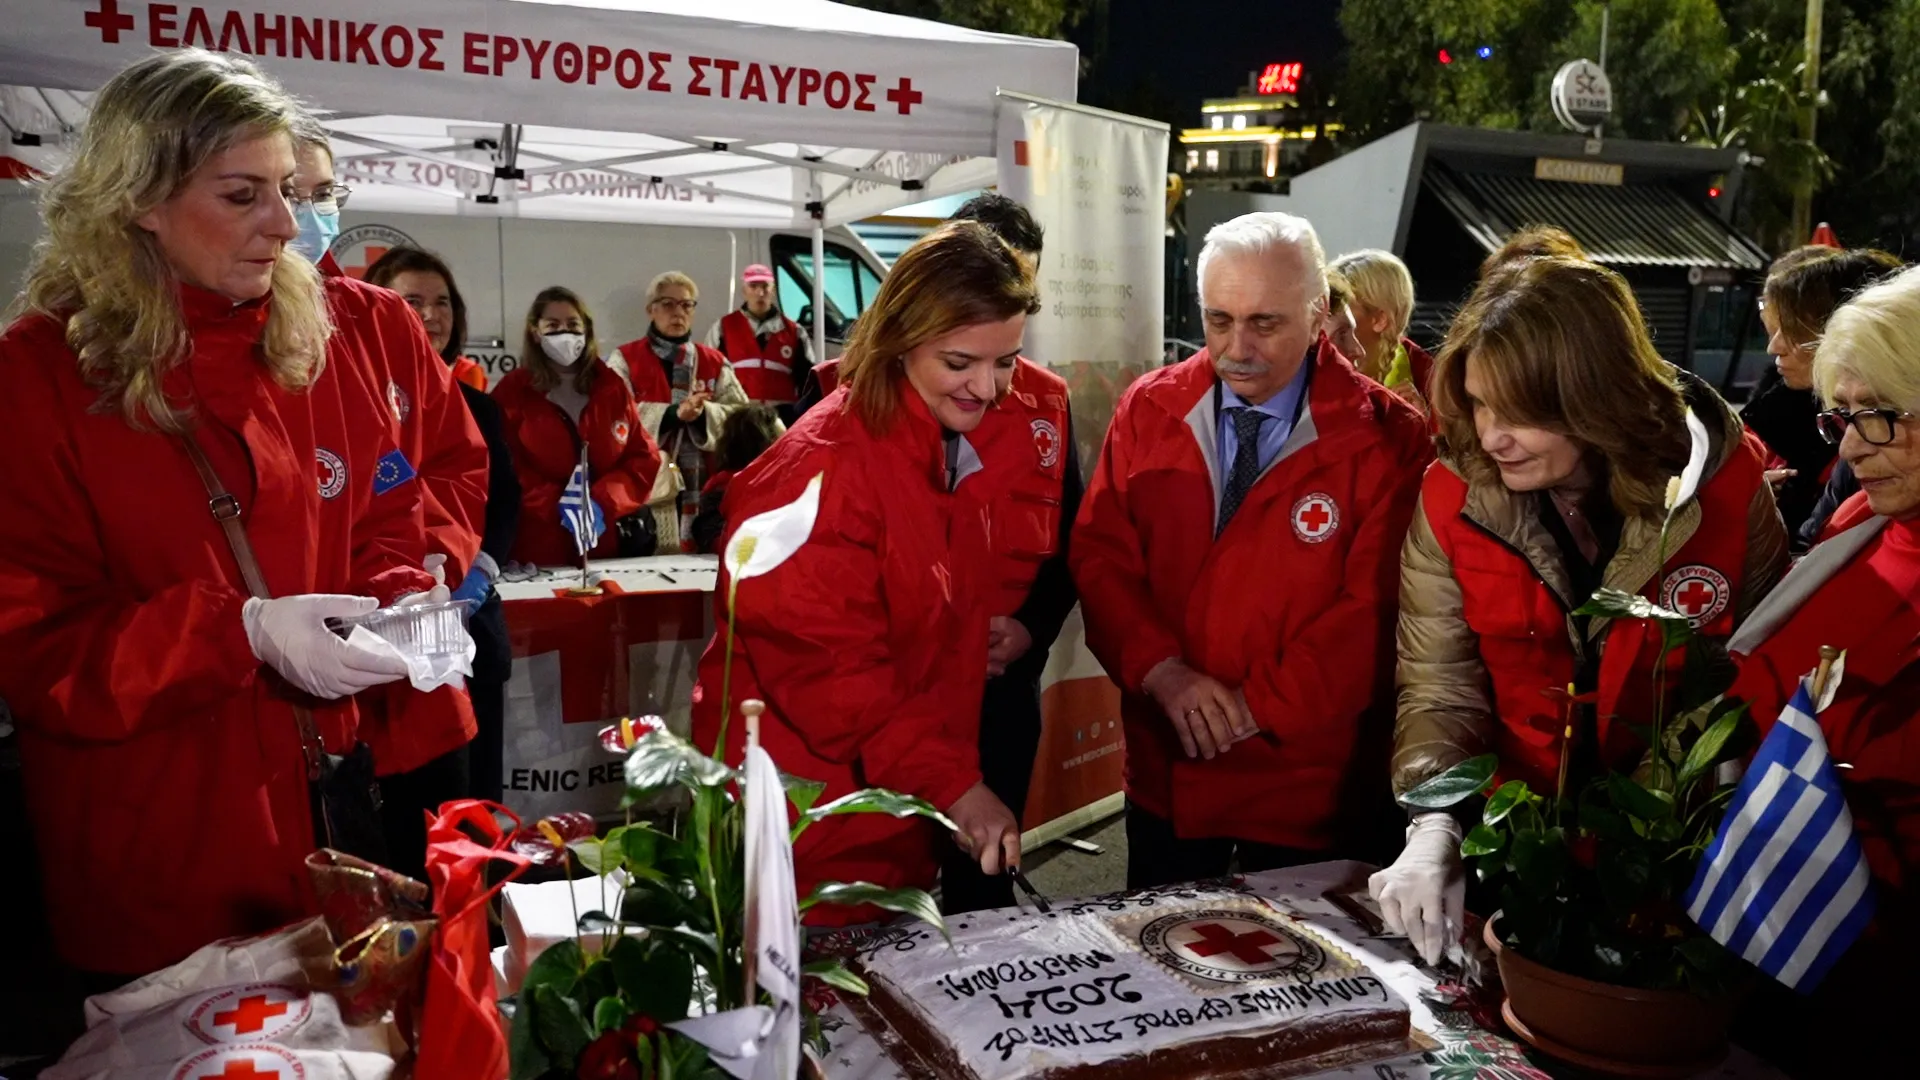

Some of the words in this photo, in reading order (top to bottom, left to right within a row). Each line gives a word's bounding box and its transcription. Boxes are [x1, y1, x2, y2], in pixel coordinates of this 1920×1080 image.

[149, 4, 444, 71] ΕΛΛΗΝΙΚΟΣ
[462, 31, 672, 93] ΕΡΥΘΡΟΣ
[687, 56, 876, 111] ΣΤΑΥΡΟΣ
[1541, 161, 1619, 184] CANTINA
[990, 973, 1144, 1019] 2024
